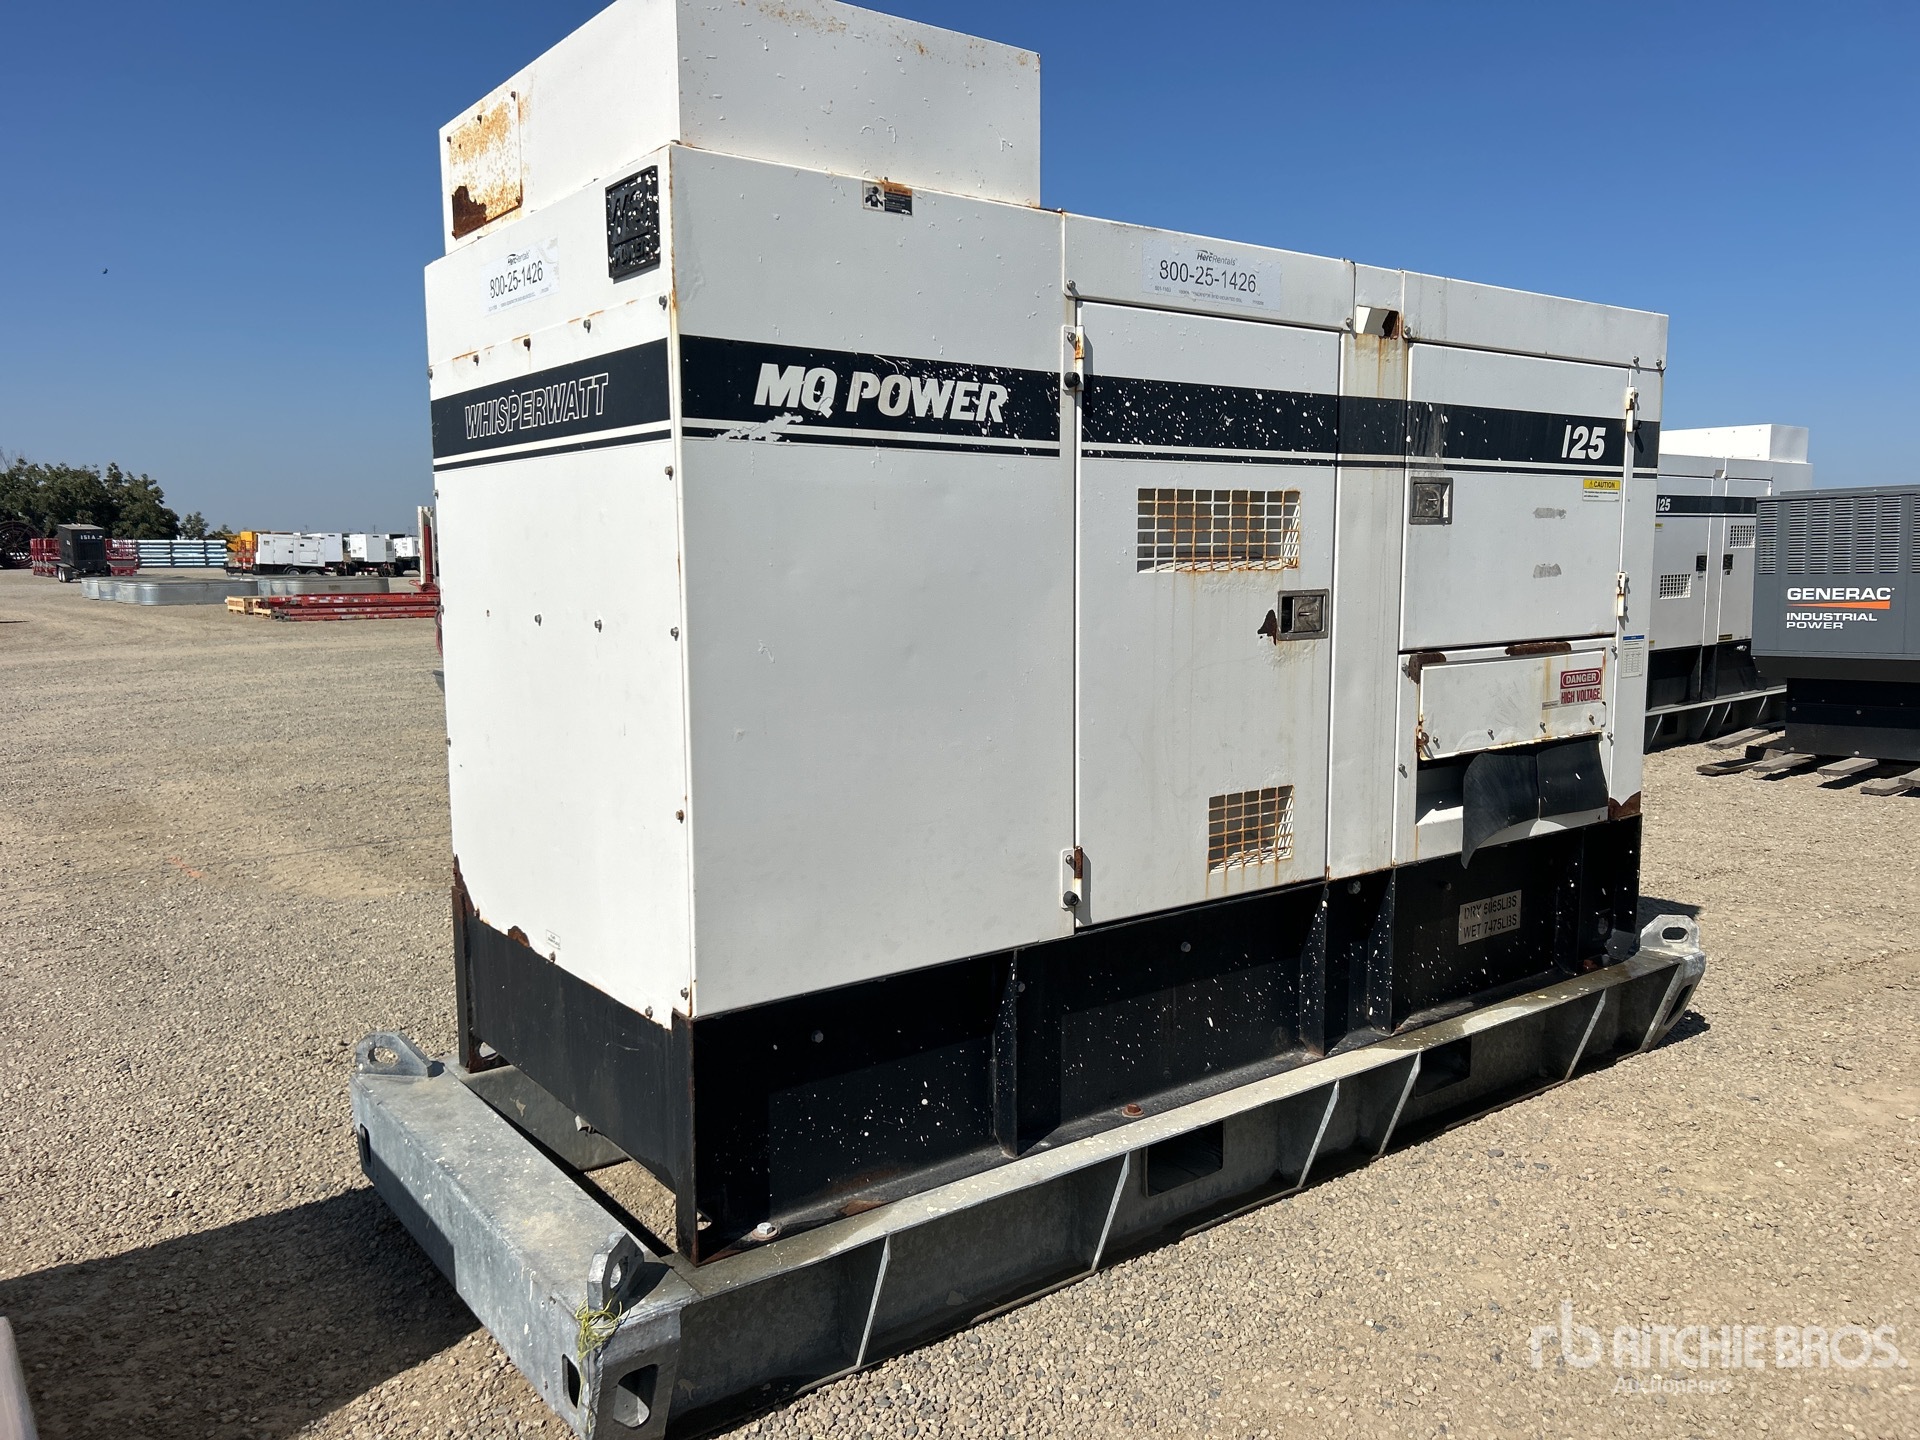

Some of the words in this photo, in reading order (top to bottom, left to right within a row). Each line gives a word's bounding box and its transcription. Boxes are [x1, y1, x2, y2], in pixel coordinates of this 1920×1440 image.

[490, 260, 543, 298] 800-25-1426
[1160, 260, 1256, 293] 800-25-1426
[753, 362, 838, 419] MQ
[845, 371, 1008, 423] POWER
[465, 372, 609, 440] WHISPERWATT
[1561, 425, 1607, 460] 125
[1593, 481, 1616, 489] CAUTION
[1656, 498, 1671, 511] 125
[1787, 587, 1891, 600] GENERAC
[1786, 612, 1878, 622] INDUSTRIAL
[1786, 621, 1844, 630] POWER
[1565, 672, 1597, 685] DANGER
[1561, 691, 1575, 704] HIGH
[1577, 687, 1601, 702] VOLTAGE
[1463, 923, 1482, 939] WET
[1484, 913, 1518, 935] 7475LBS
